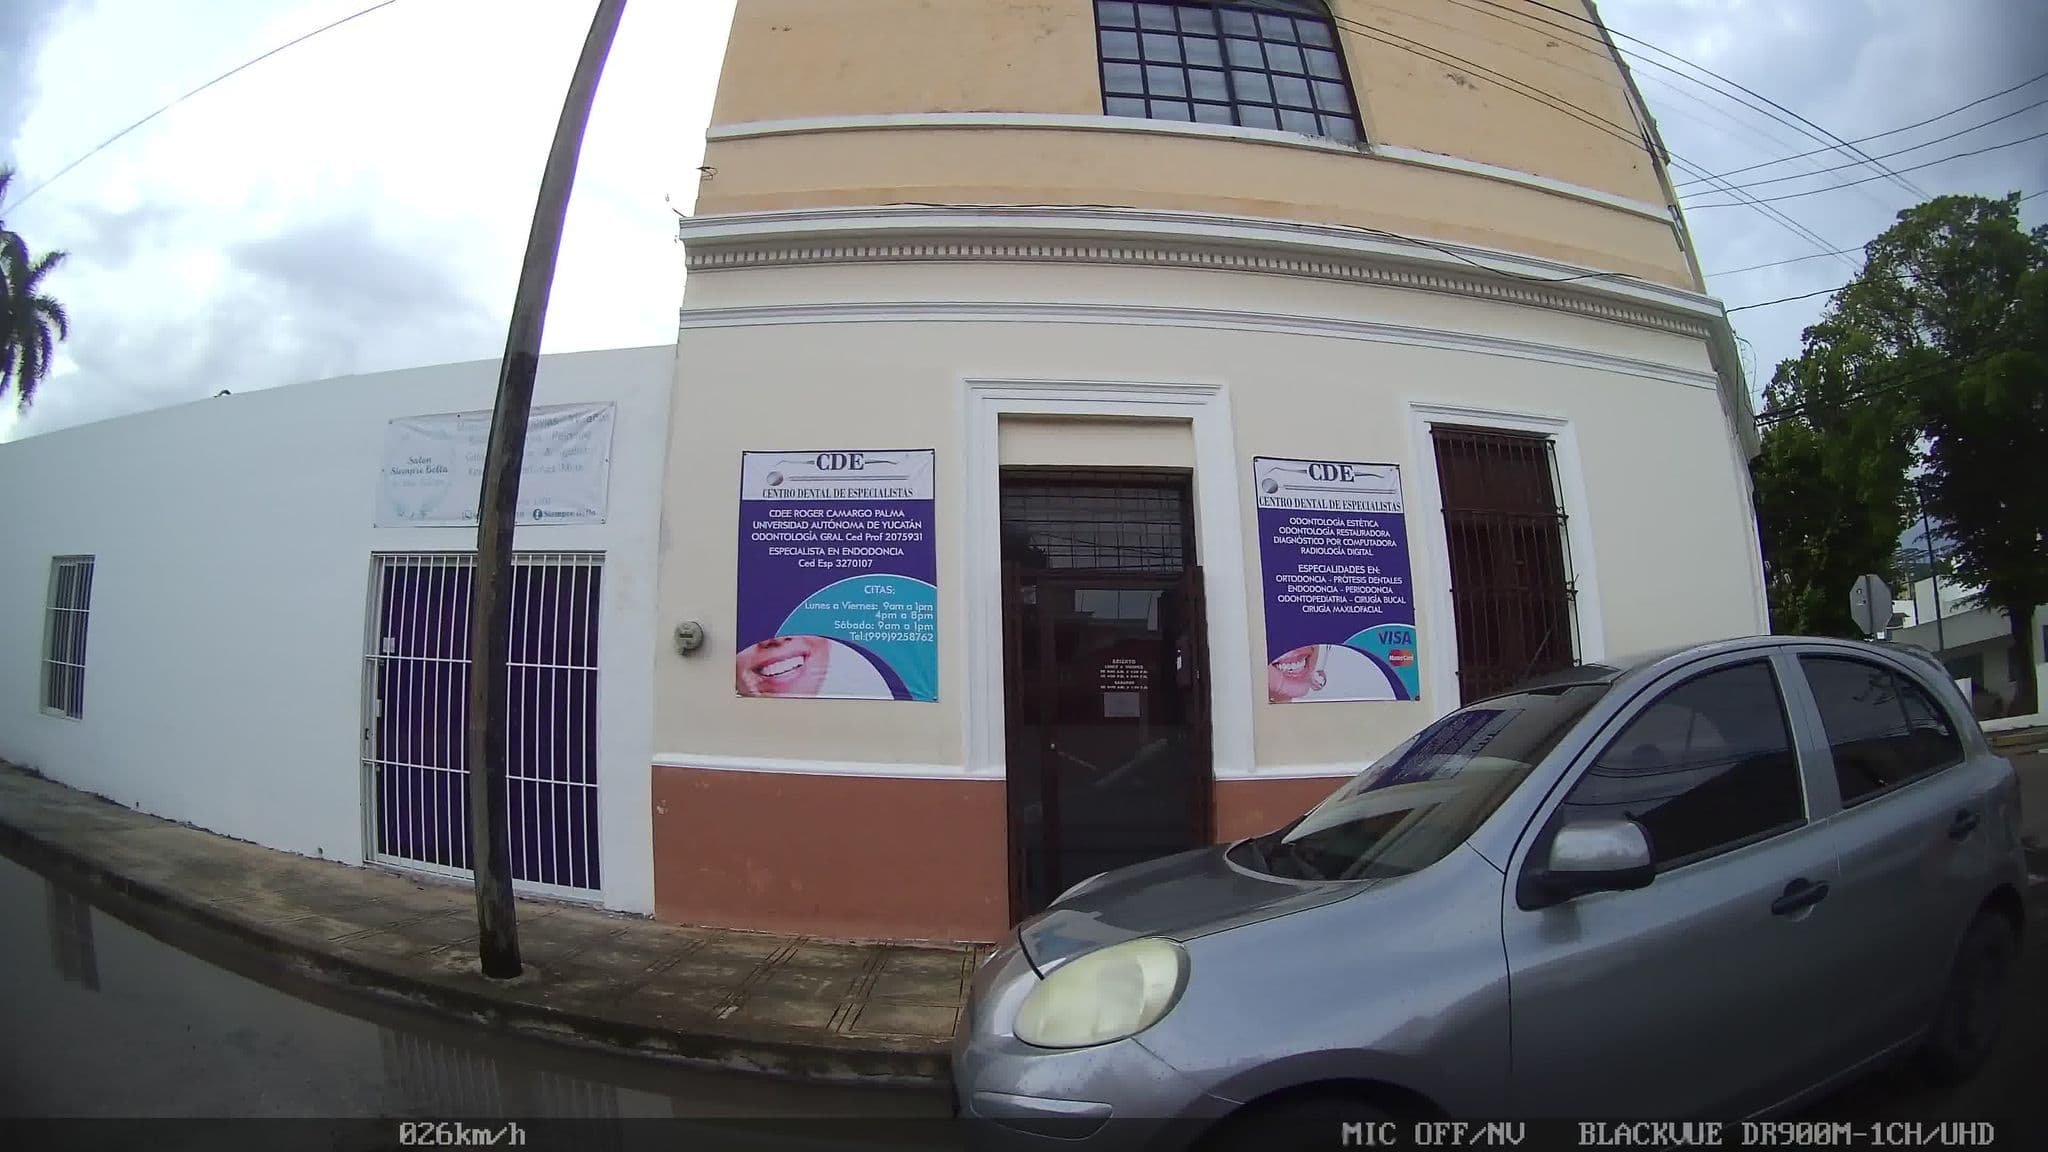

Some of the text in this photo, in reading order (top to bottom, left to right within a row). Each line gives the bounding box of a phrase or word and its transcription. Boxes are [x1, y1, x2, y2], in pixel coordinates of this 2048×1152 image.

[816, 453, 864, 471] CDE
[1308, 463, 1355, 483] CDE
[762, 487, 914, 498] CENTRO DENTAL DE ESPECIALISTAS
[1259, 496, 1401, 512] CENTRO DENTAL DE ESPECIALISTAS
[769, 509, 905, 518] CDEE ROGER CAMARGO PALMA
[752, 518, 922, 530] UNIVERSIDAD AUTÓNOMA DE YUCATÁN
[1289, 516, 1379, 528] ODONTOLOGÍA ESTÉTICA
[751, 530, 923, 542] ODONTOLOGÍA GRAL Ced Prof 2075931
[1278, 526, 1391, 538] ODONTOLOGÍA RESTAURADORA
[1273, 535, 1398, 547] DIAGNÓSTICO POR COMPUTADORA
[768, 547, 904, 556] ESPECIALISTA EN ENDODONCIA
[1300, 546, 1374, 556] RADIOLOGÍA DIGITAL
[798, 559, 873, 570] Ced Esp 3270107
[1298, 564, 1366, 574] ESPECIALIDADES
[1275, 574, 1327, 583] ORTODONCIA
[1368, 576, 1403, 585] DENTALES
[864, 585, 896, 595] CITAS:
[1287, 585, 1339, 593] ENDODONCIA
[1345, 585, 1394, 594] PERIODONCIA
[1354, 594, 1382, 604] CIRUGÍA
[1383, 596, 1407, 604] BUCAL
[804, 602, 831, 611] Lunes
[841, 601, 878, 610] Viernes:
[882, 601, 904, 611] 9am
[915, 601, 933, 613] 1pm
[1302, 603, 1384, 614] CIRUGÍA MAXILOFACIAL
[875, 610, 897, 621] 4pm
[911, 610, 933, 621] 8pm
[834, 620, 875, 630] Sábado:
[877, 620, 901, 630] 9am
[914, 621, 933, 632] 1pm
[1378, 631, 1412, 645] VISA
